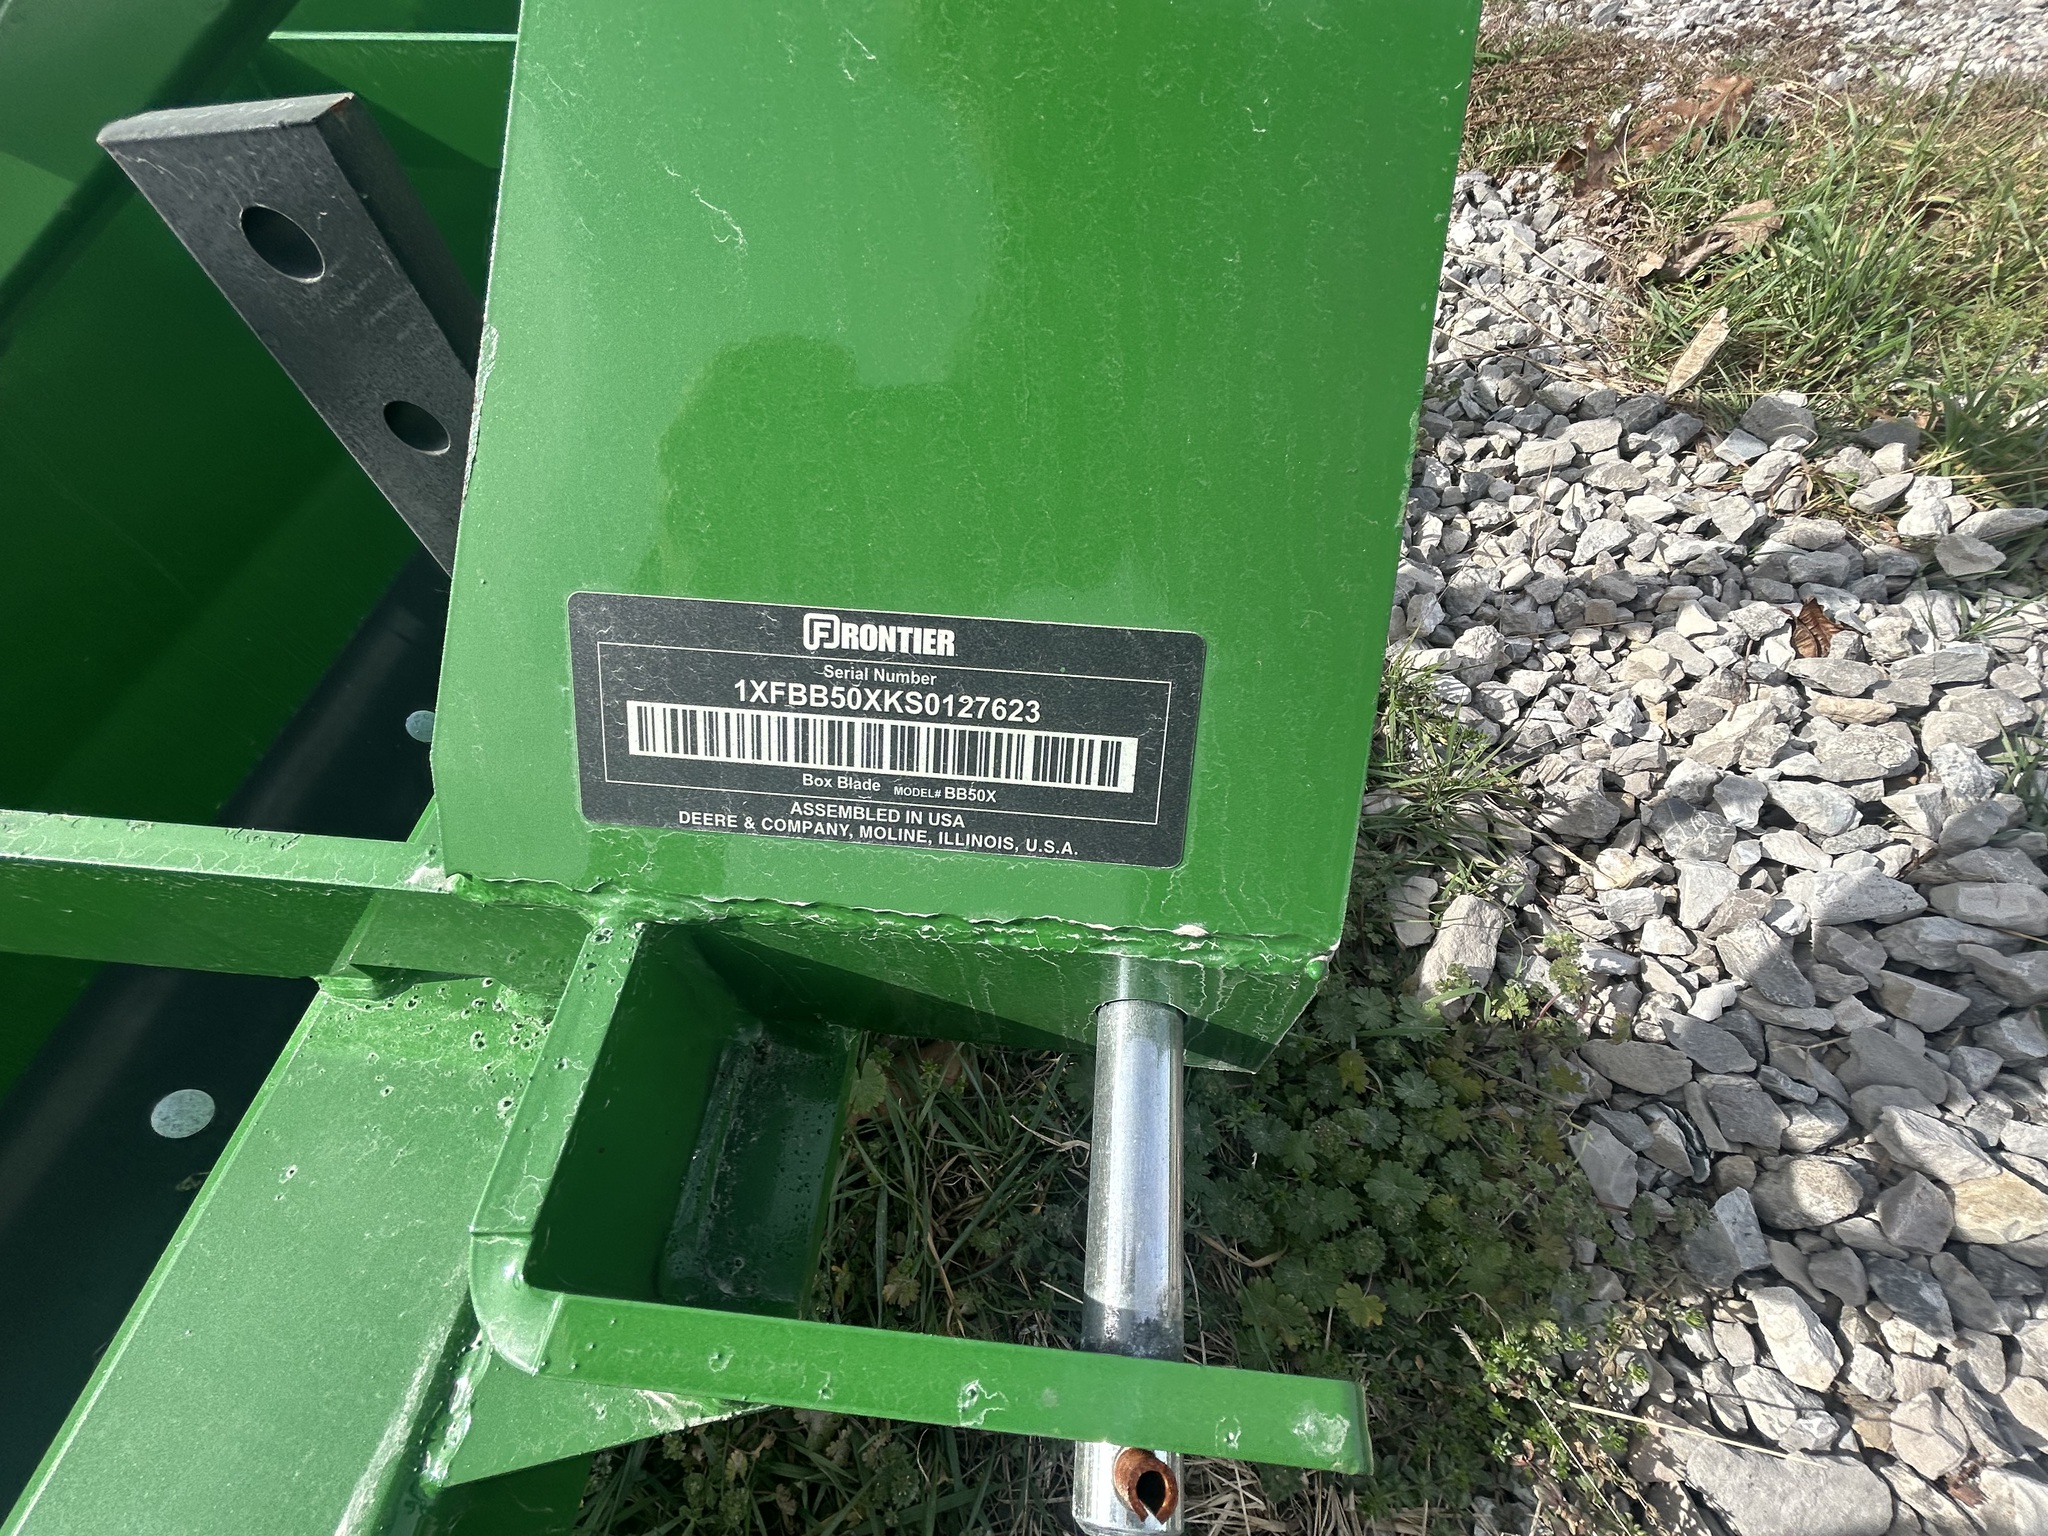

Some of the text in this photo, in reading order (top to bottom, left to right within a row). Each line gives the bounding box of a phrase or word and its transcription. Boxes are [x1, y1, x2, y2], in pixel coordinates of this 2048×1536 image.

[803, 613, 957, 657] FRONTIER
[824, 664, 938, 686] Serial Number
[734, 679, 1042, 724] 1XFBB50XKS0127623
[802, 773, 997, 803] Box Blade MODEL# BB50X
[678, 810, 1079, 856] DEERE & COMPANY, MOLINE, ILLINOIS, U.S.A.
[790, 801, 966, 829] ASSEMBLED IN USA
